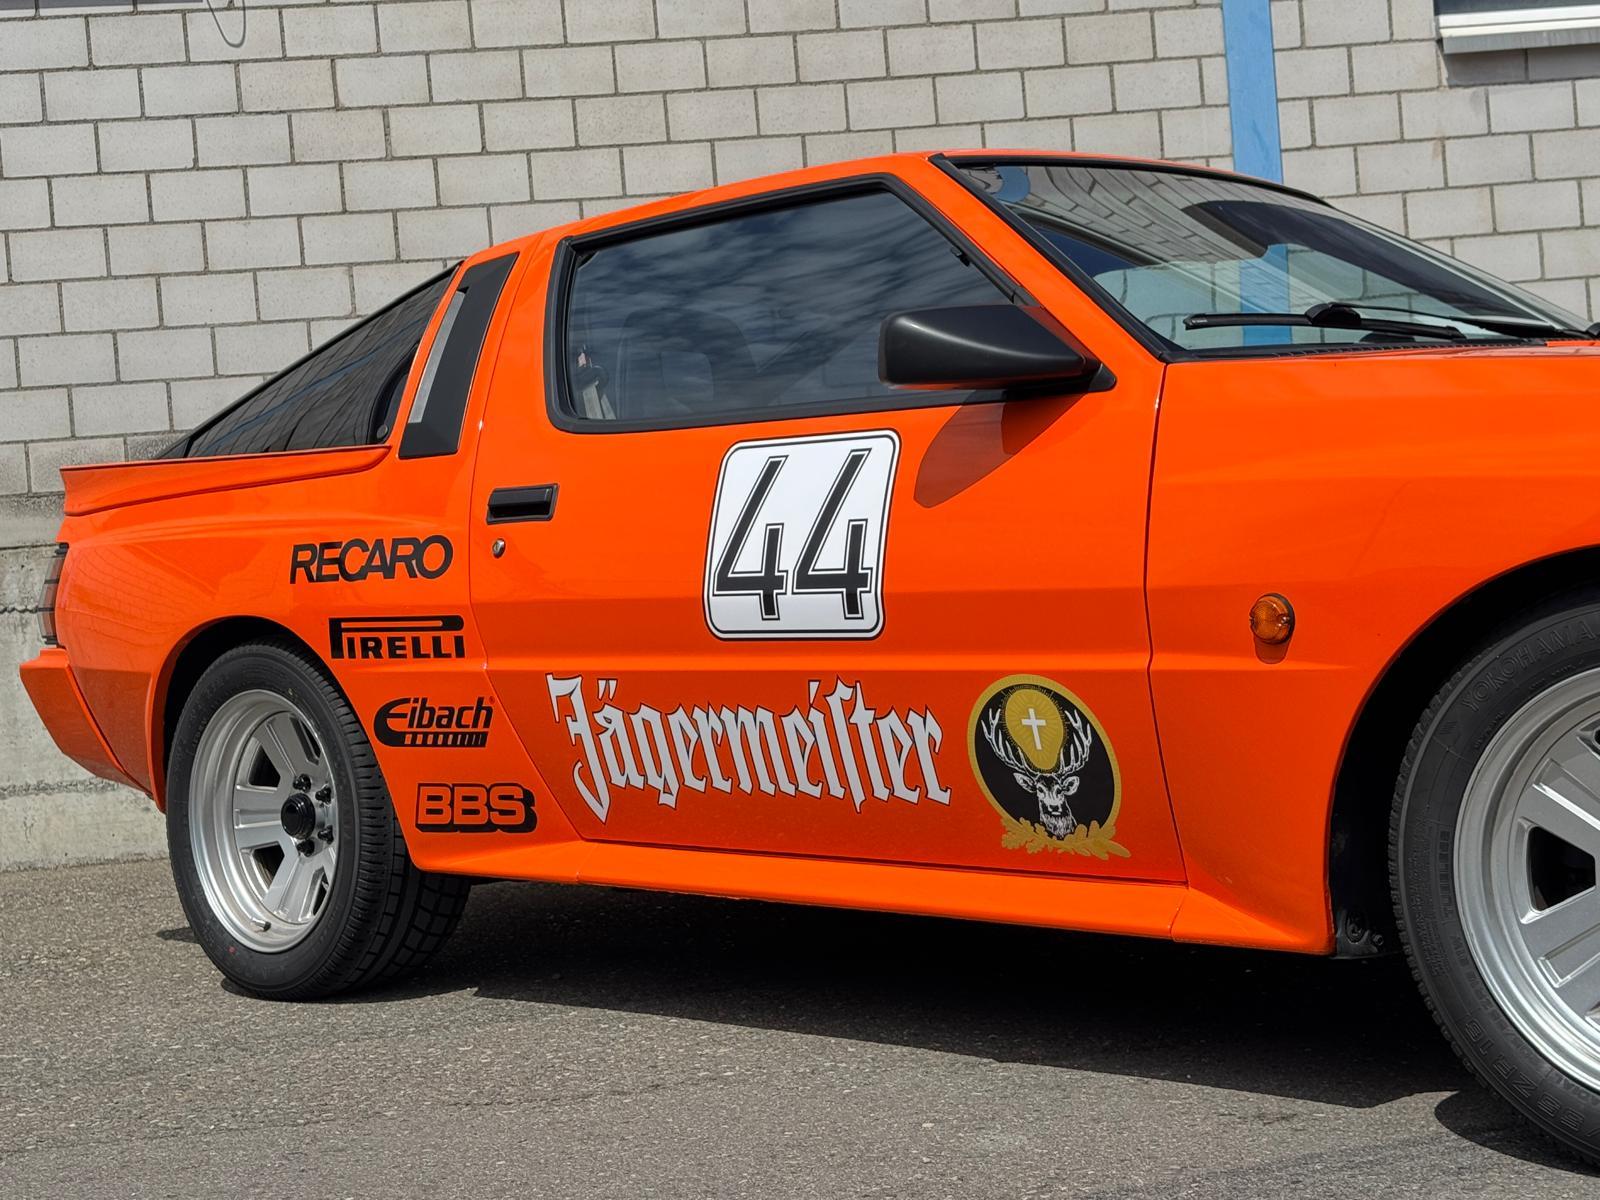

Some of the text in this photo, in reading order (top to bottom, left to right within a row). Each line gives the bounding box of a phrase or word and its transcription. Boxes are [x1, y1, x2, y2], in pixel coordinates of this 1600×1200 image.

[712, 447, 872, 621] 44
[289, 535, 453, 584] RECARO
[328, 615, 466, 659] PIRELLI
[1461, 620, 1597, 712] YOKOHAMA
[374, 697, 494, 748] Eibach
[415, 783, 537, 833] BBS
